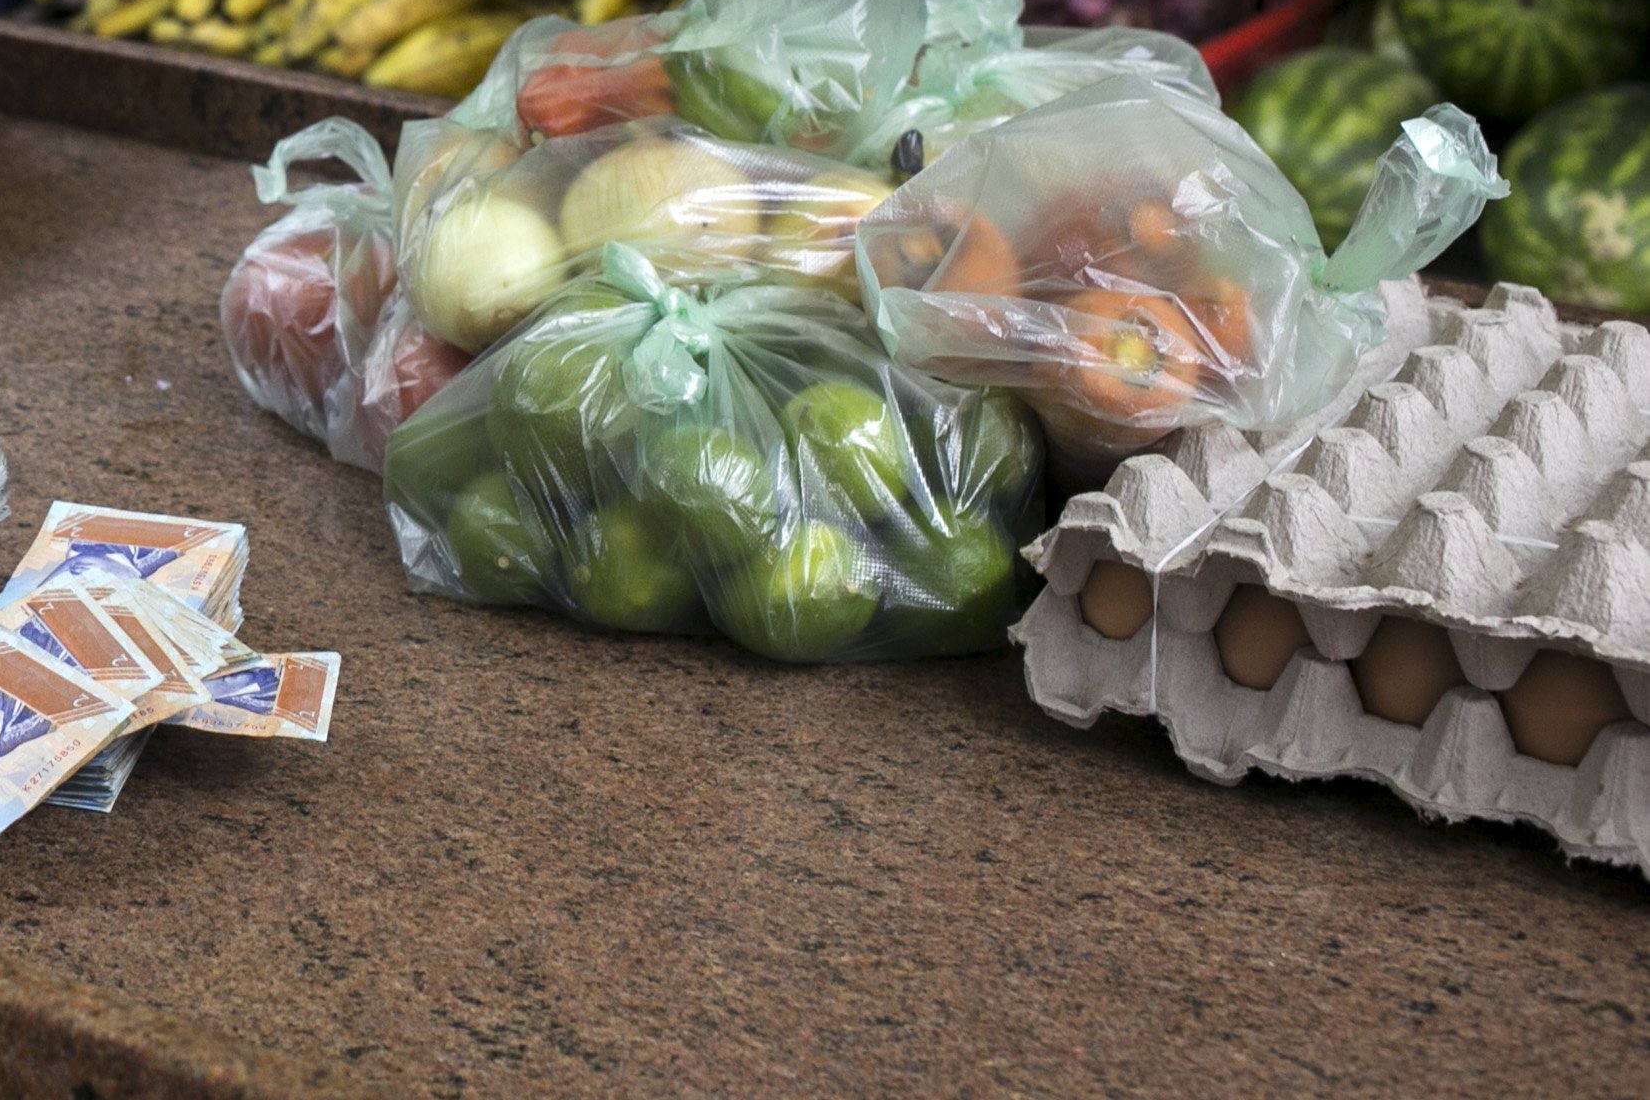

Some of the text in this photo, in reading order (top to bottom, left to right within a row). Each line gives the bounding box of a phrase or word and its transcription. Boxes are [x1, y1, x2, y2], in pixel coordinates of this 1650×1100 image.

[70, 526, 84, 537] 2
[38, 601, 55, 615] 2
[112, 653, 129, 667] 2
[72, 693, 91, 708] 2
